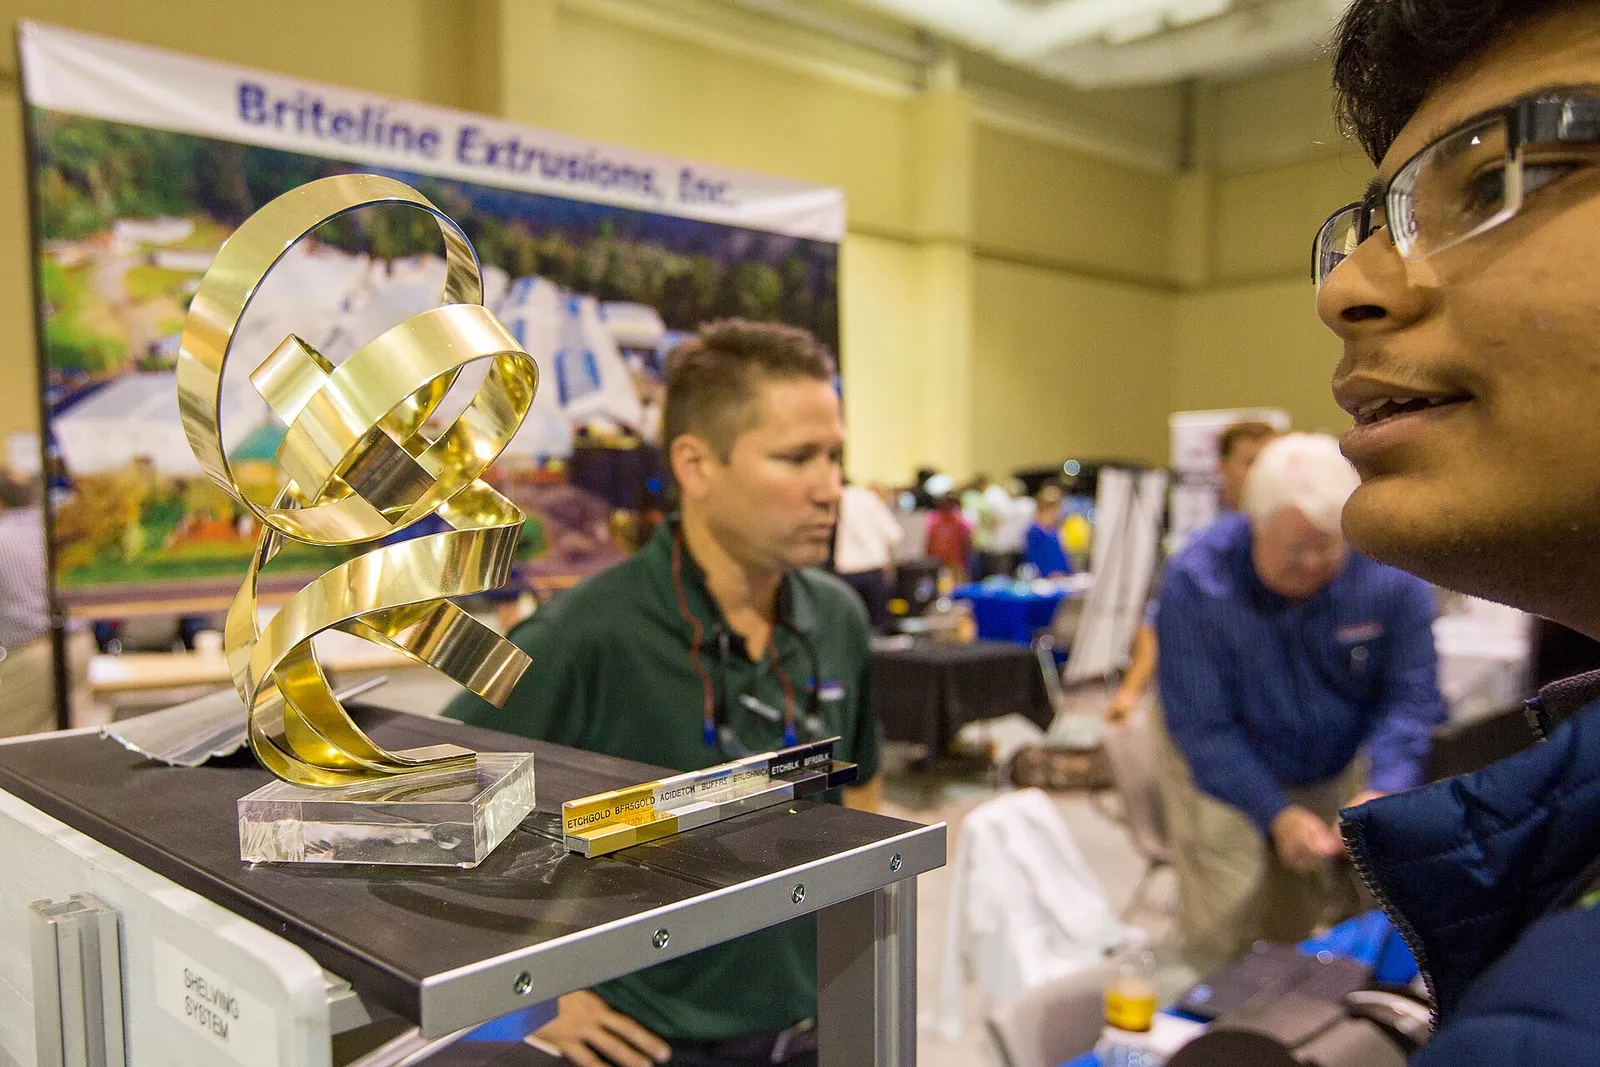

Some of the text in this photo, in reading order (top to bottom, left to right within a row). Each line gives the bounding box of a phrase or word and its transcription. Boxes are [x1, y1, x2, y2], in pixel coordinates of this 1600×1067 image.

[237, 80, 738, 208] Briteline Extrusions, Inc.
[567, 809, 611, 828] ETCHGOLD
[660, 785, 696, 802] ACIDETCH
[771, 760, 800, 775] ETCHBLK
[184, 967, 240, 1019] SHELVING
[185, 995, 229, 1041] SYSTEM
